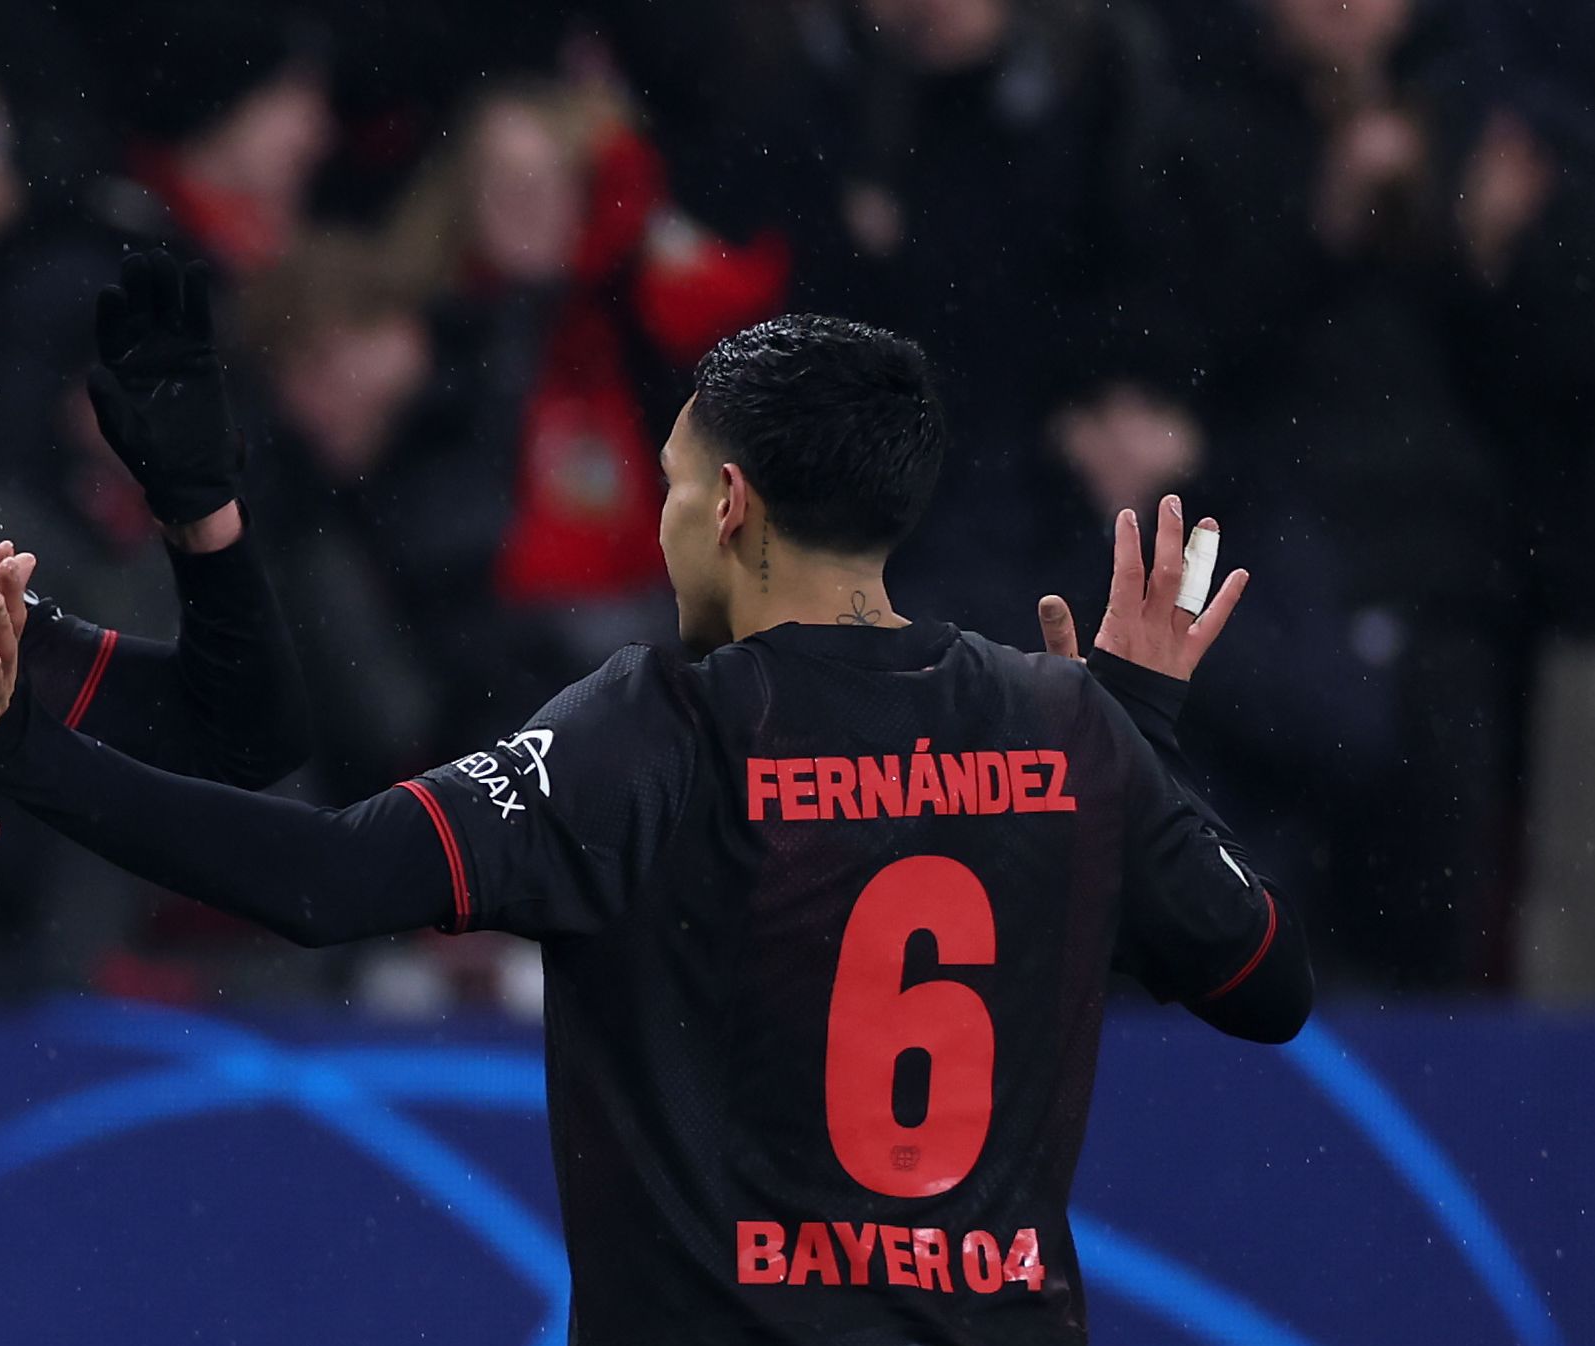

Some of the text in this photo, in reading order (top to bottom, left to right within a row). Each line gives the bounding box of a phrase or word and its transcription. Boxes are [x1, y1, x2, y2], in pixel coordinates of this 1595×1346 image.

[451, 751, 526, 820] EDAX
[746, 738, 1077, 821] FERNÁNDEZ
[825, 855, 996, 1198] 6
[736, 1220, 1046, 1294] BAYER 04
